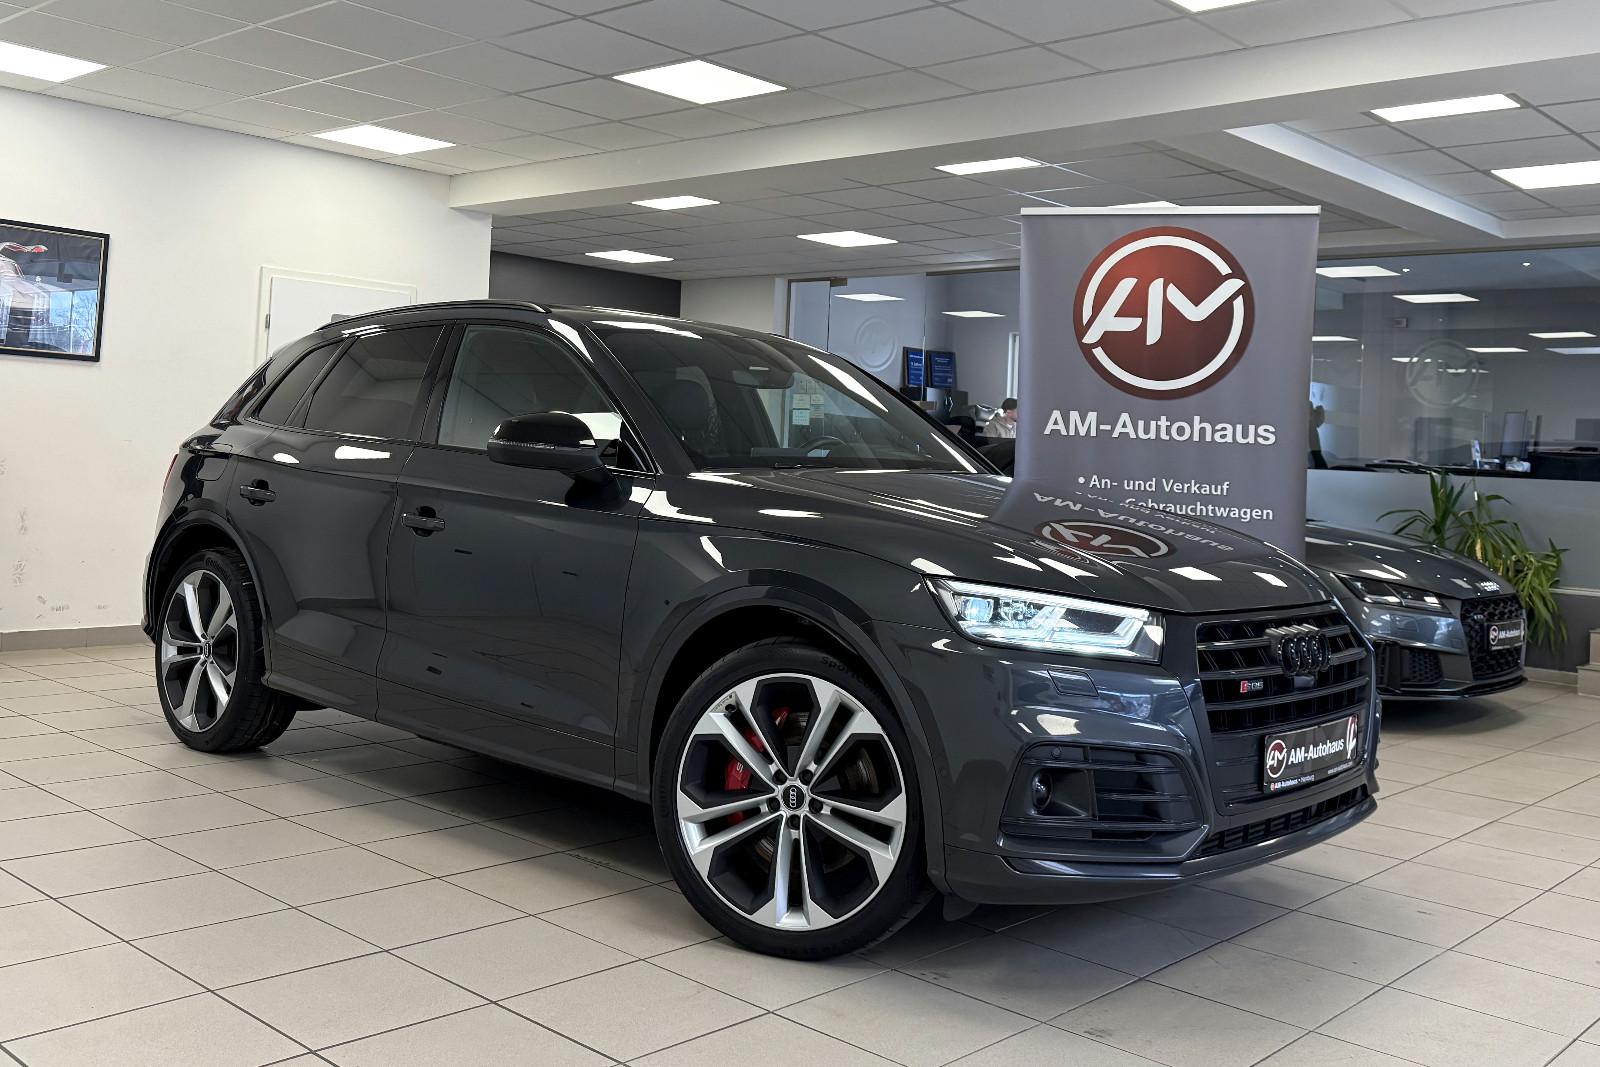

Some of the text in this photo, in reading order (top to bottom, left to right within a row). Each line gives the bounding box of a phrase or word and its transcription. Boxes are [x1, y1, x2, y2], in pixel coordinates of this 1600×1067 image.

[1044, 410, 1277, 446] AM-Autohaus
[1089, 475, 1230, 497] An- und Verkauf
[1288, 739, 1345, 765] AM-Autohaus
